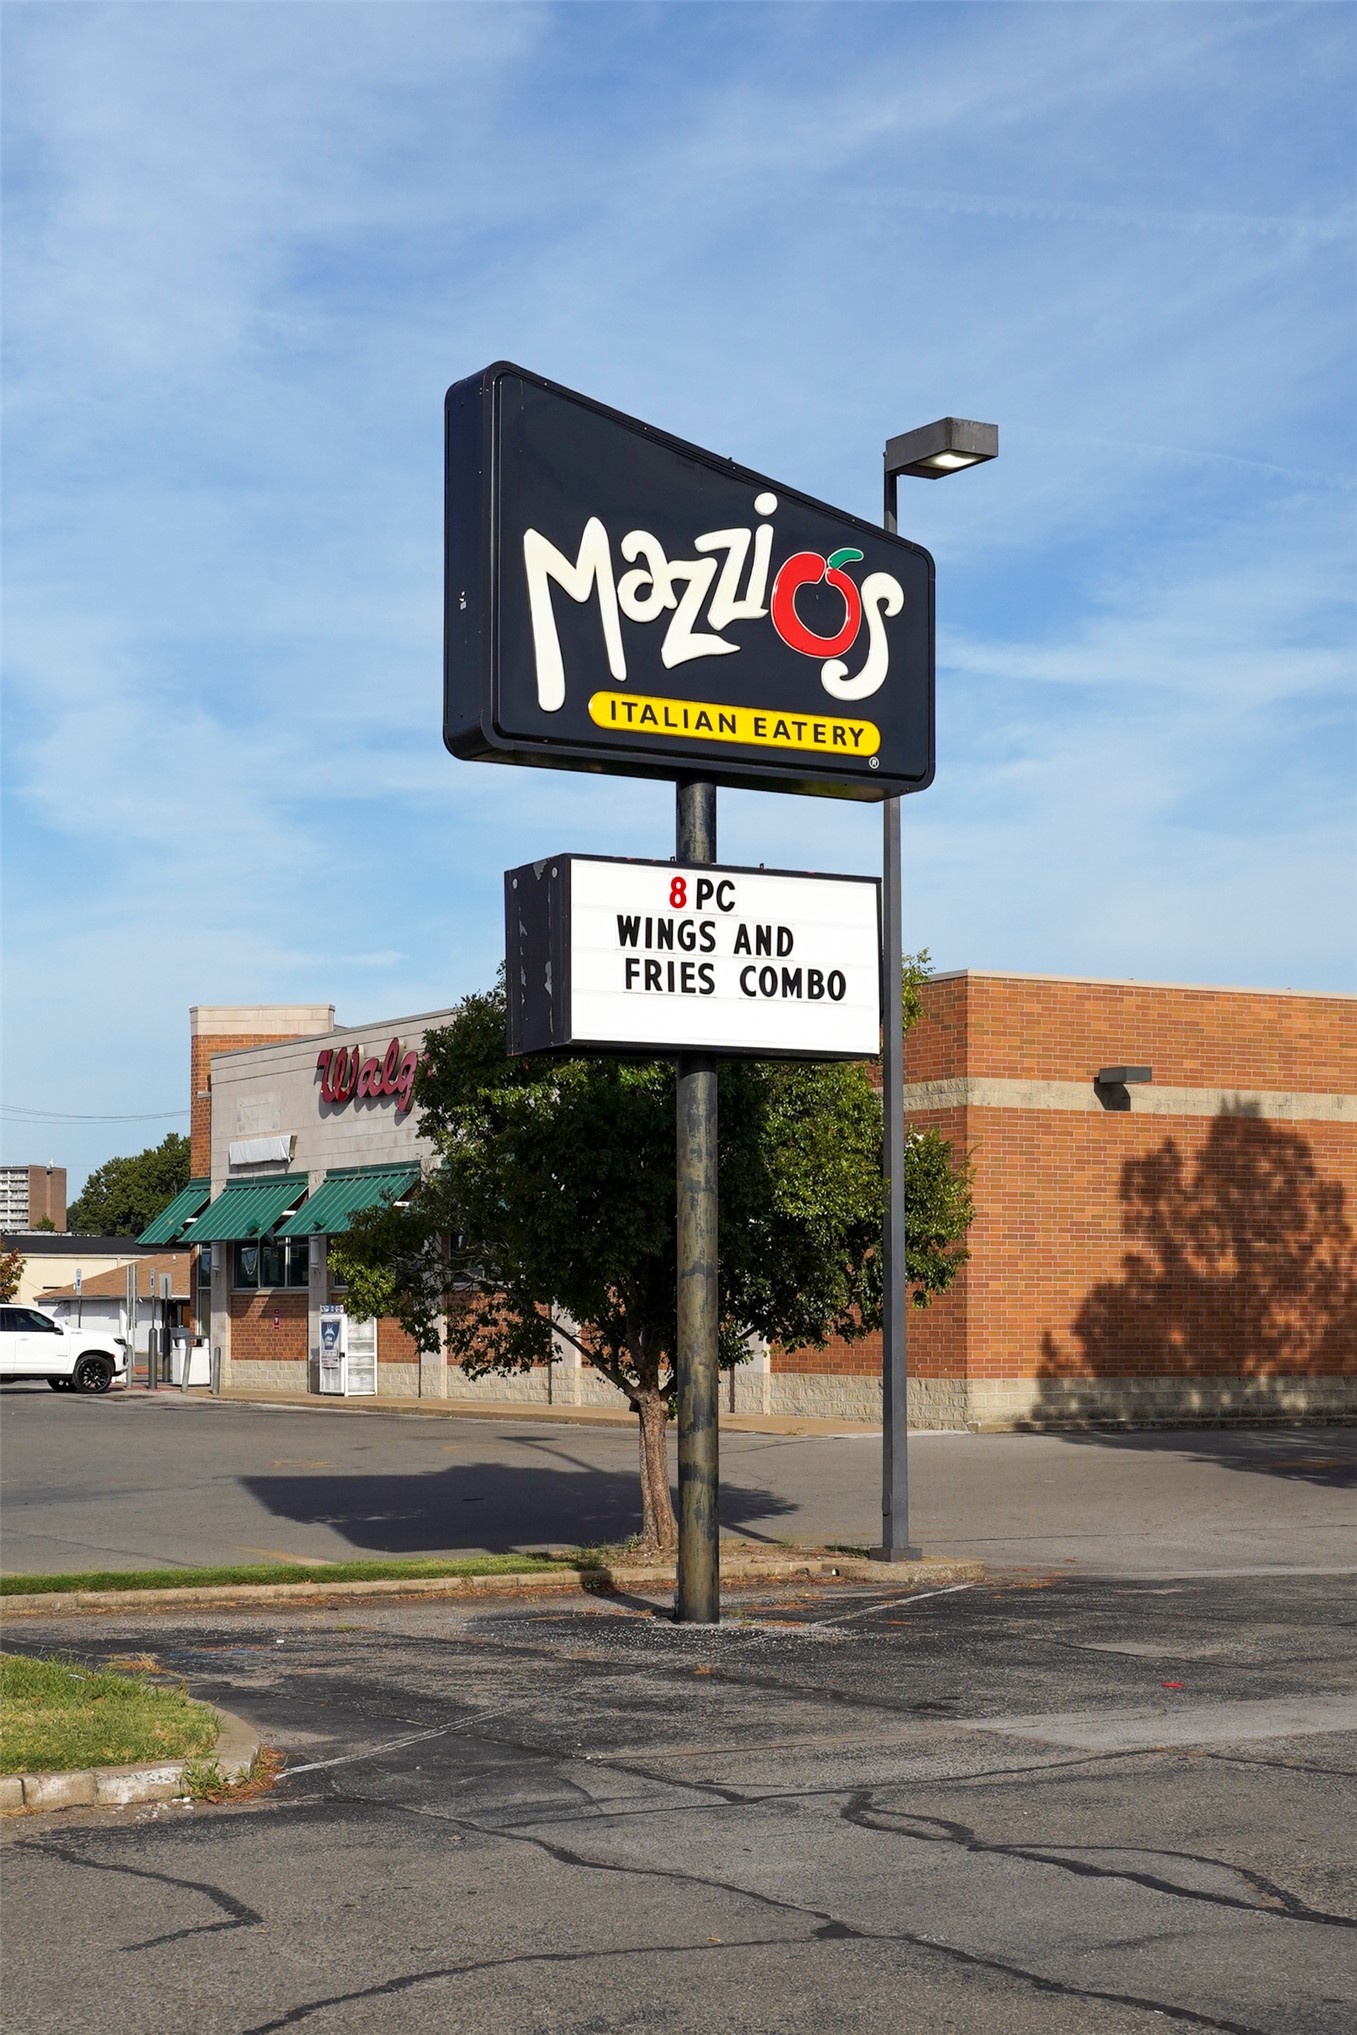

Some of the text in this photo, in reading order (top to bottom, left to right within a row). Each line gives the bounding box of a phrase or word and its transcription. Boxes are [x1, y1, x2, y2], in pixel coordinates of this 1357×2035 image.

[610, 700, 864, 748] ITALIAN EATERY
[616, 914, 794, 957] WINGS AND
[624, 958, 847, 1001] FRIES COMBO
[316, 1037, 430, 1113] Walg
